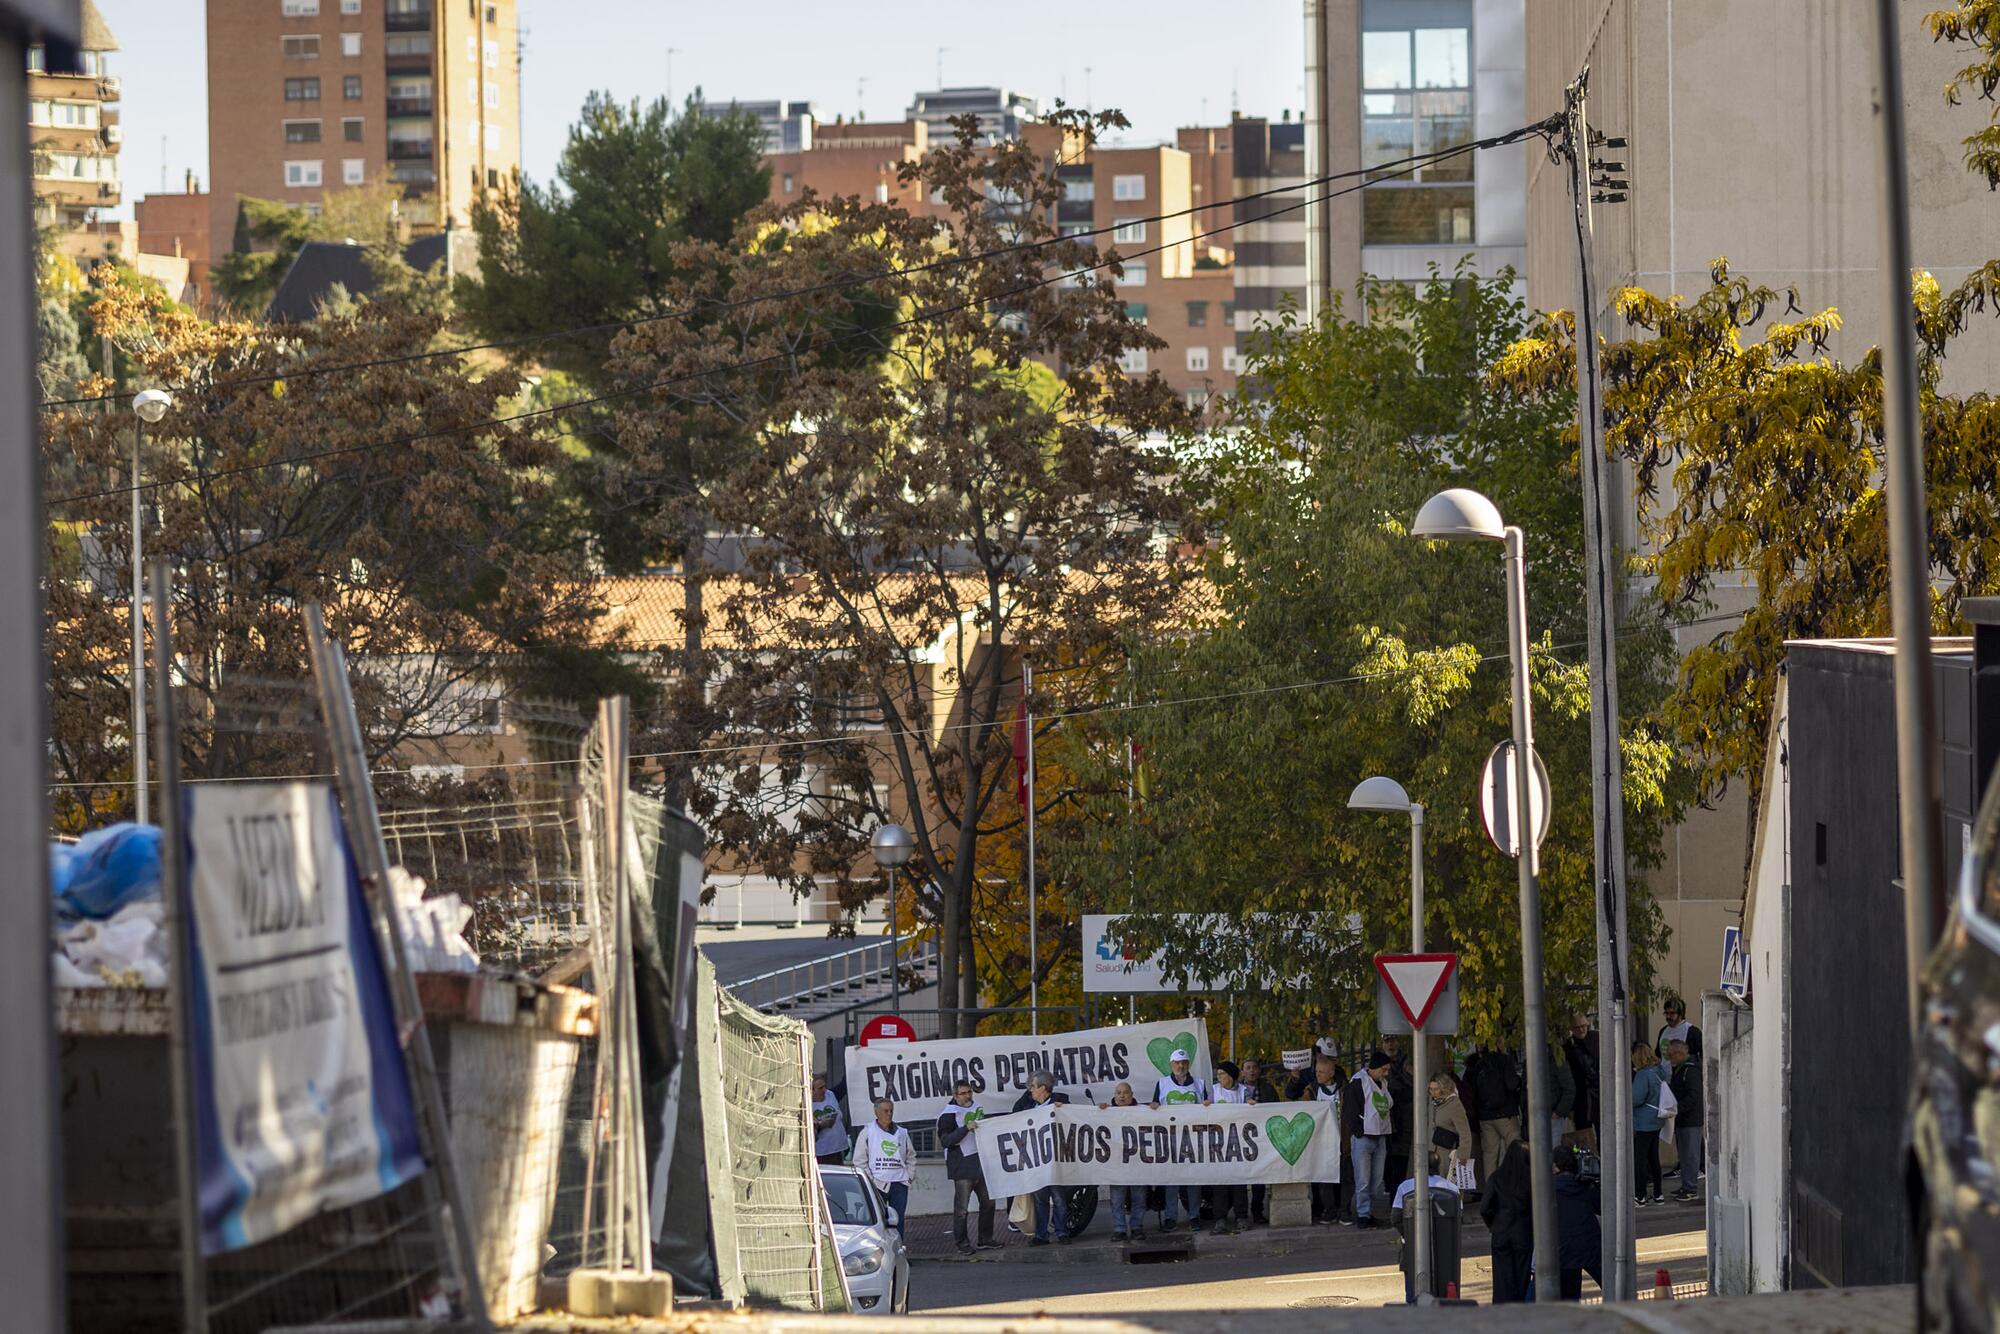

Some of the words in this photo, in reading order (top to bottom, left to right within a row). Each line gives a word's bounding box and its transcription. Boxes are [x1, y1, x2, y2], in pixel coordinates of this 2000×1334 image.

[866, 1051, 986, 1104] EXIGIMOS
[995, 1041, 1130, 1092] PEDIATRAS
[997, 1111, 1111, 1172] EXIGIMOS
[1121, 1116, 1258, 1163] PEDIATRAS
